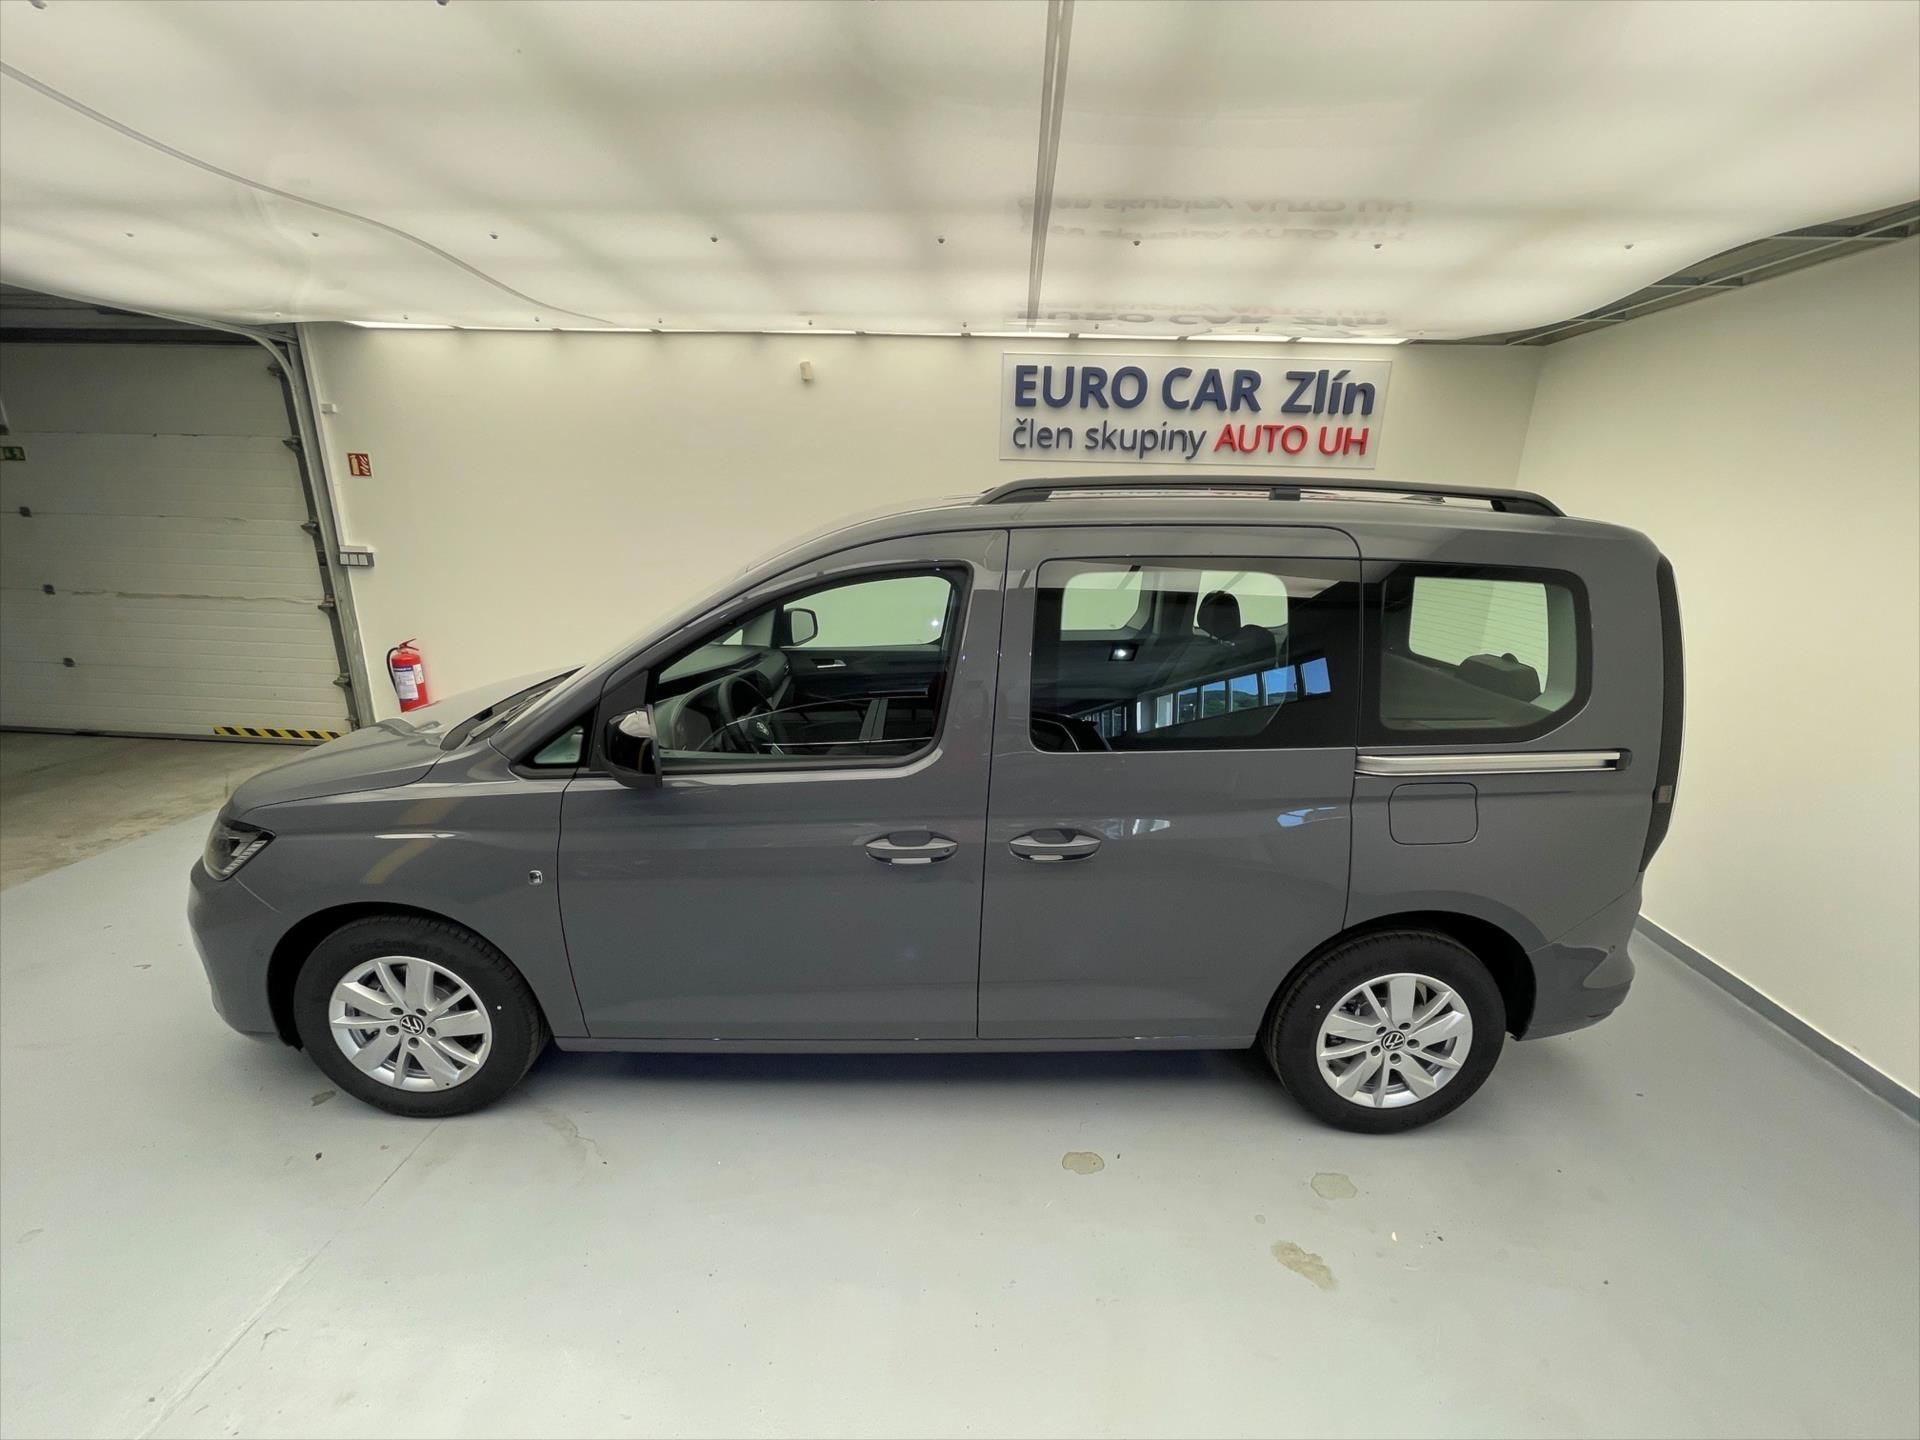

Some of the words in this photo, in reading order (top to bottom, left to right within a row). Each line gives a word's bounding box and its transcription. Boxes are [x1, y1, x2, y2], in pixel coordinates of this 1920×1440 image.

[1015, 364, 1148, 409] EURO
[1162, 367, 1262, 412] CAR
[1281, 369, 1376, 416] Zlín
[1012, 417, 1074, 449] člen
[1084, 419, 1207, 460] skupiny
[1213, 423, 1308, 455] AUTO
[1318, 425, 1369, 456] UH
